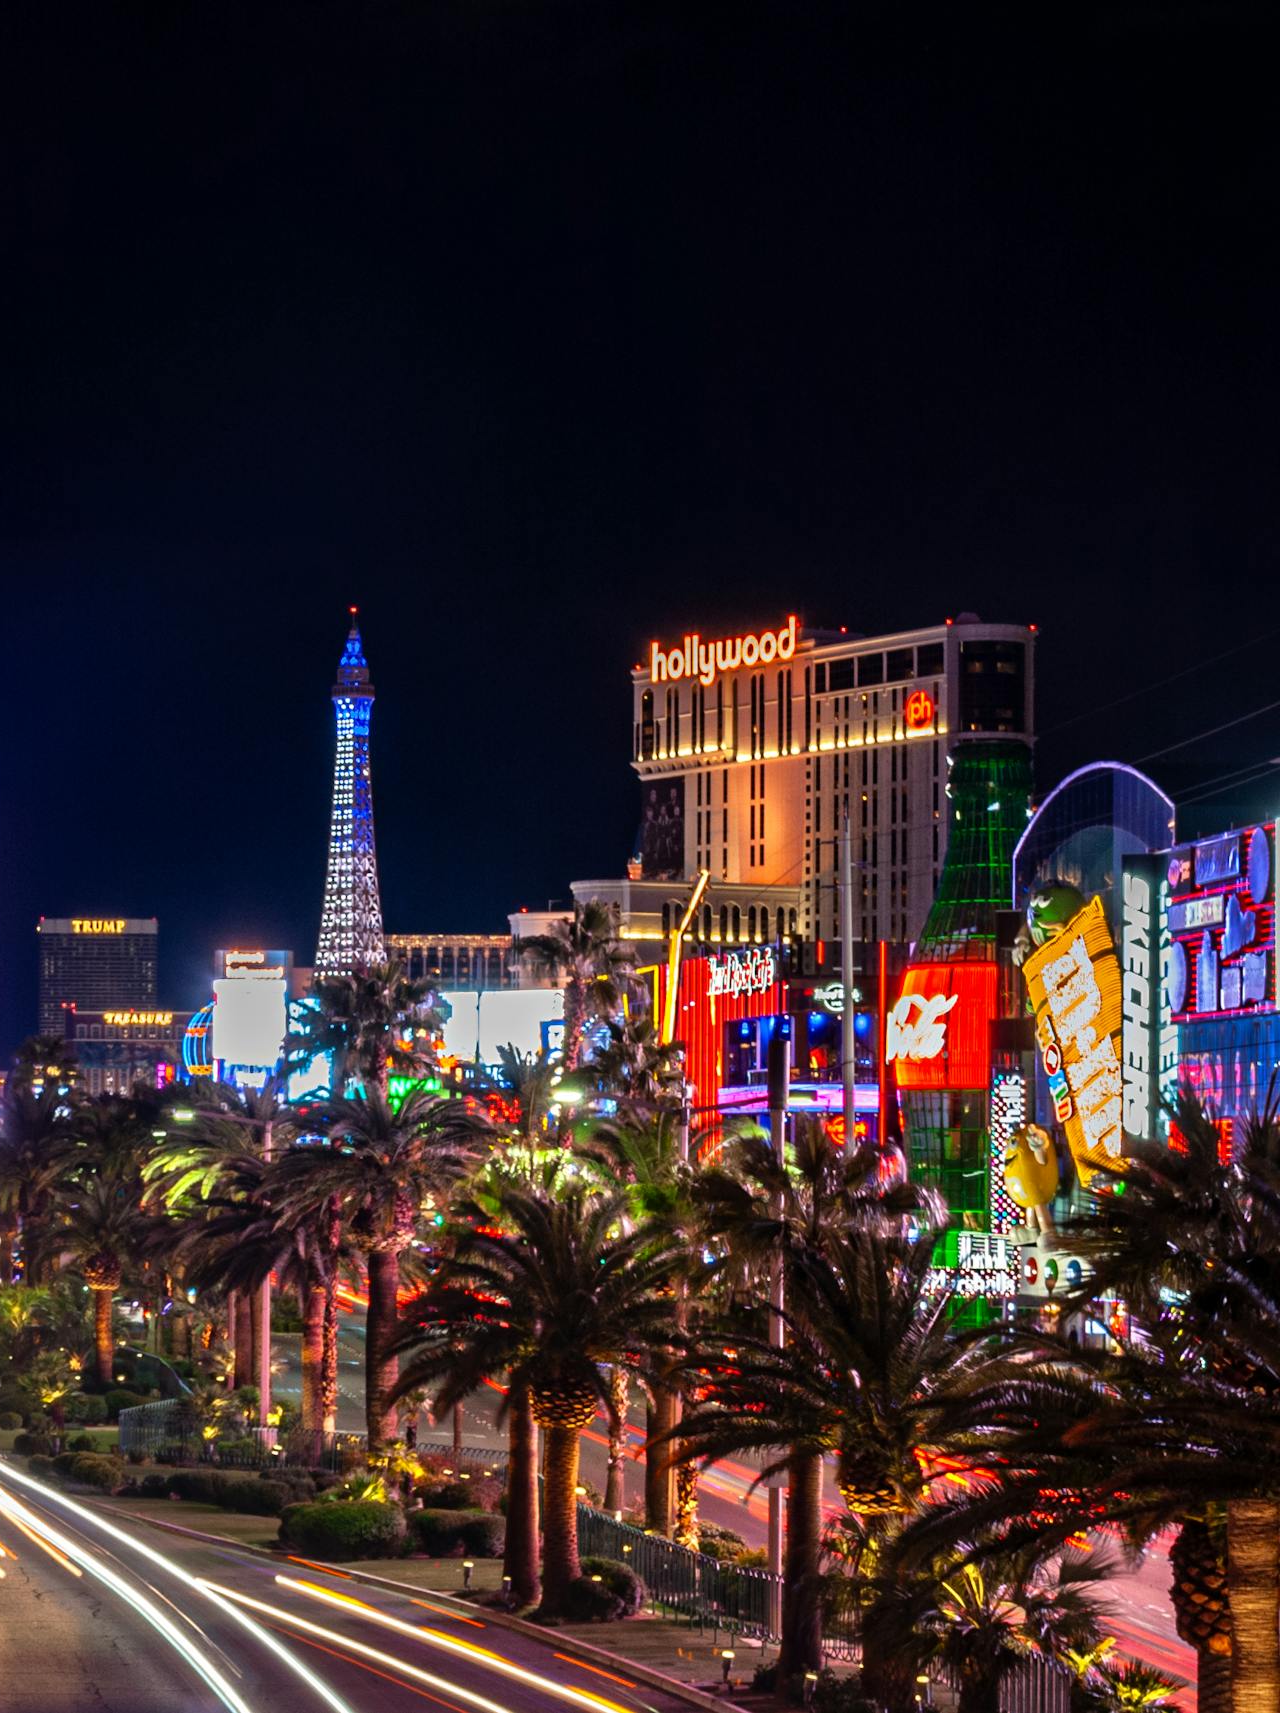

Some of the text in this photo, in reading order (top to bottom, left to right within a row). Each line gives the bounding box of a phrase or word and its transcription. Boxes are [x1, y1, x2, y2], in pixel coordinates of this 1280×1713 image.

[650, 614, 797, 687] hollywood
[71, 919, 127, 934] TRUMP
[103, 1012, 173, 1026] TREASURE
[1122, 873, 1151, 1140] SKECHERS
[921, 1269, 1016, 1296] Mrshalls
